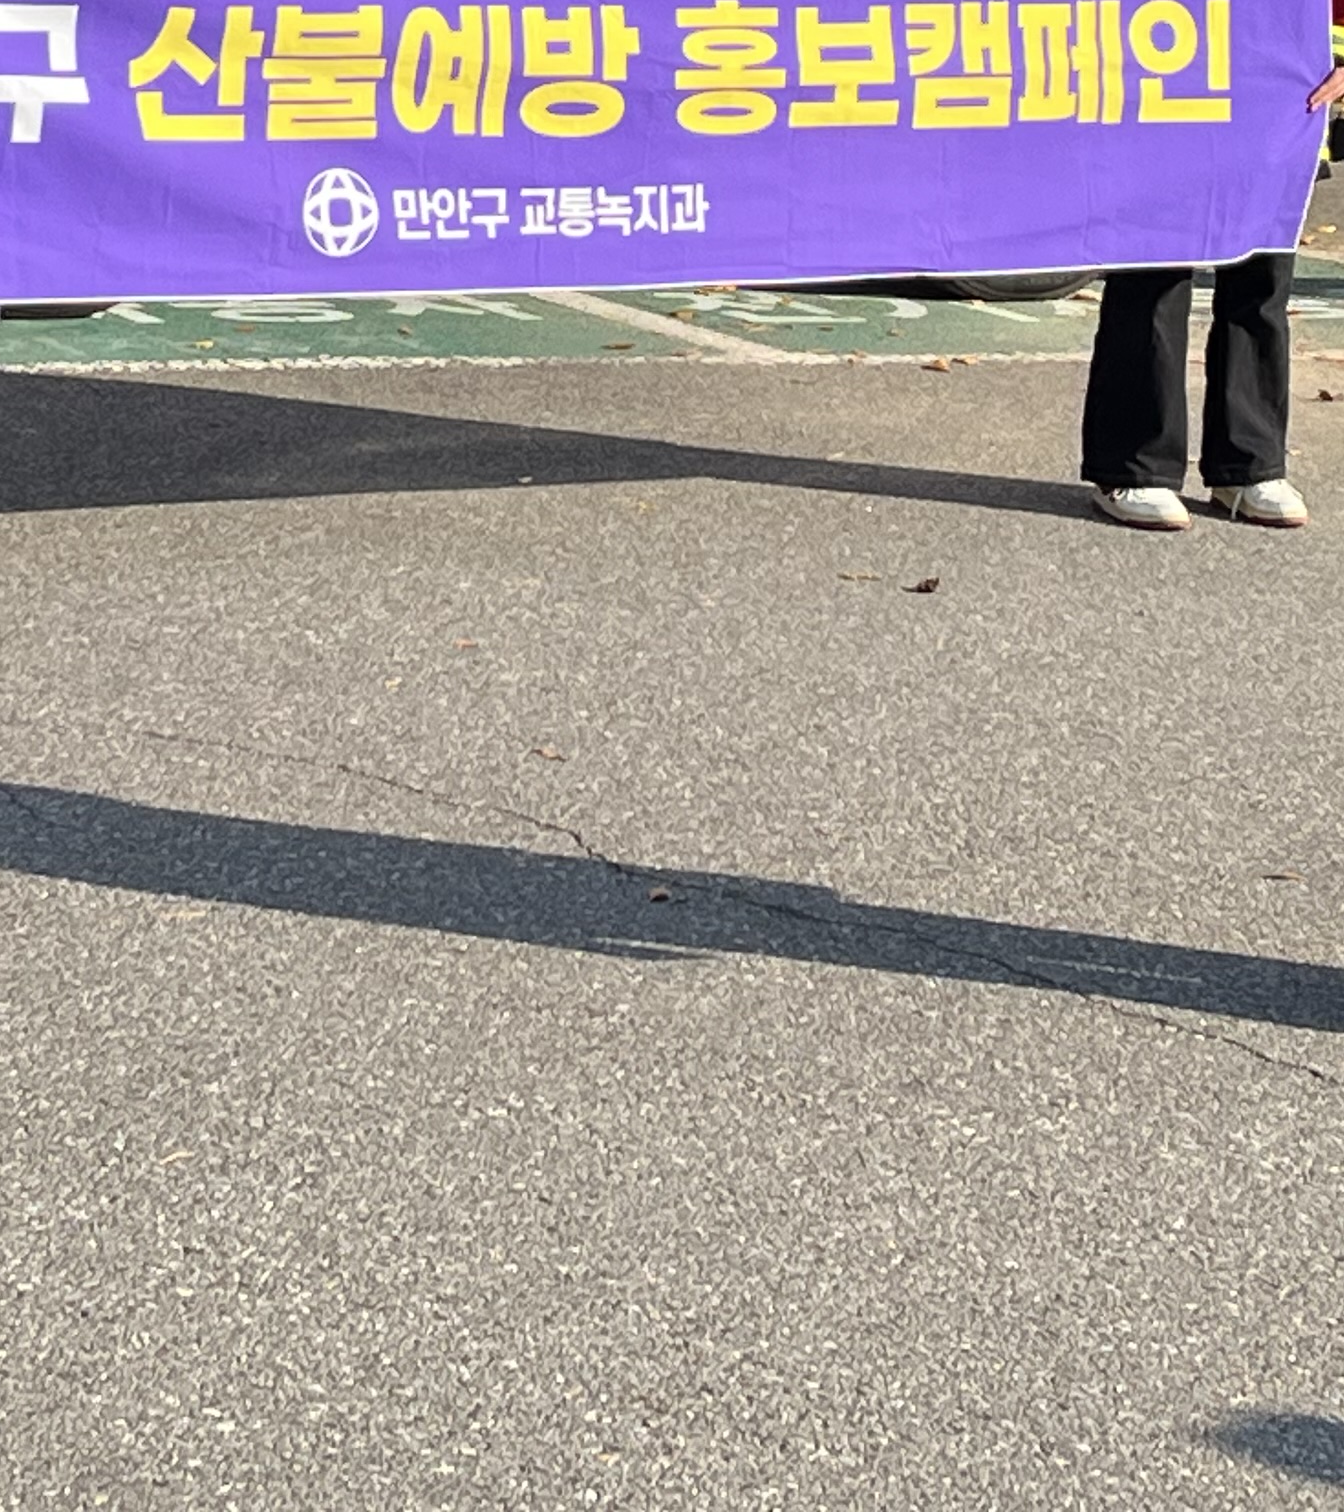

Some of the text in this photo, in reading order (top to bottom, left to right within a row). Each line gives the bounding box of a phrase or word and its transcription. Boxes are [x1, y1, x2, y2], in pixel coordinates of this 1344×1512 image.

[128, 5, 641, 139] 산불예방
[392, 182, 710, 241] 만안구 교통녹지과
